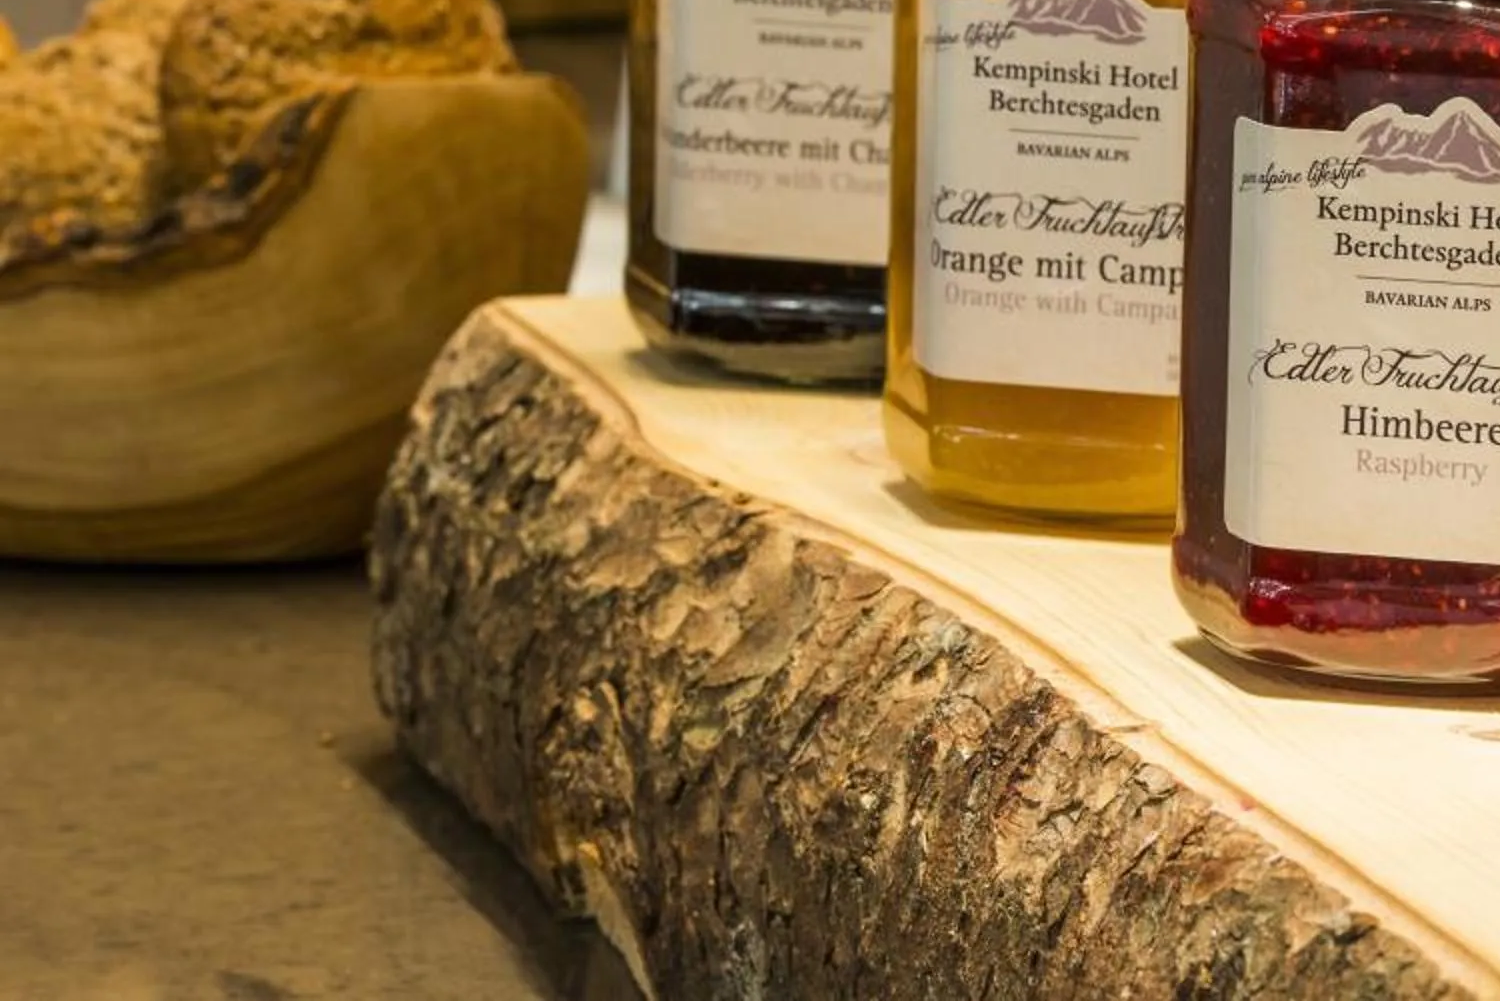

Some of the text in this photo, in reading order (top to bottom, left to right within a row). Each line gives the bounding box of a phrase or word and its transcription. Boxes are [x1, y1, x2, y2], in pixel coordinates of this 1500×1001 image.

[973, 56, 1179, 91] Kempinski Hotel
[989, 90, 1161, 124] Berchtesgaden
[800, 137, 839, 161] mit
[1016, 142, 1130, 162] BAVARIAN ALPS
[930, 186, 1008, 229] Edler
[1317, 197, 1459, 232] Kempinski
[931, 239, 1185, 294] Orange mit Camp
[945, 281, 1027, 312] Orange
[1036, 290, 1087, 315] with
[1365, 291, 1491, 312] BAVARIAN ALPS
[1249, 339, 1353, 386] Edler
[1356, 450, 1488, 486] Raspberry
